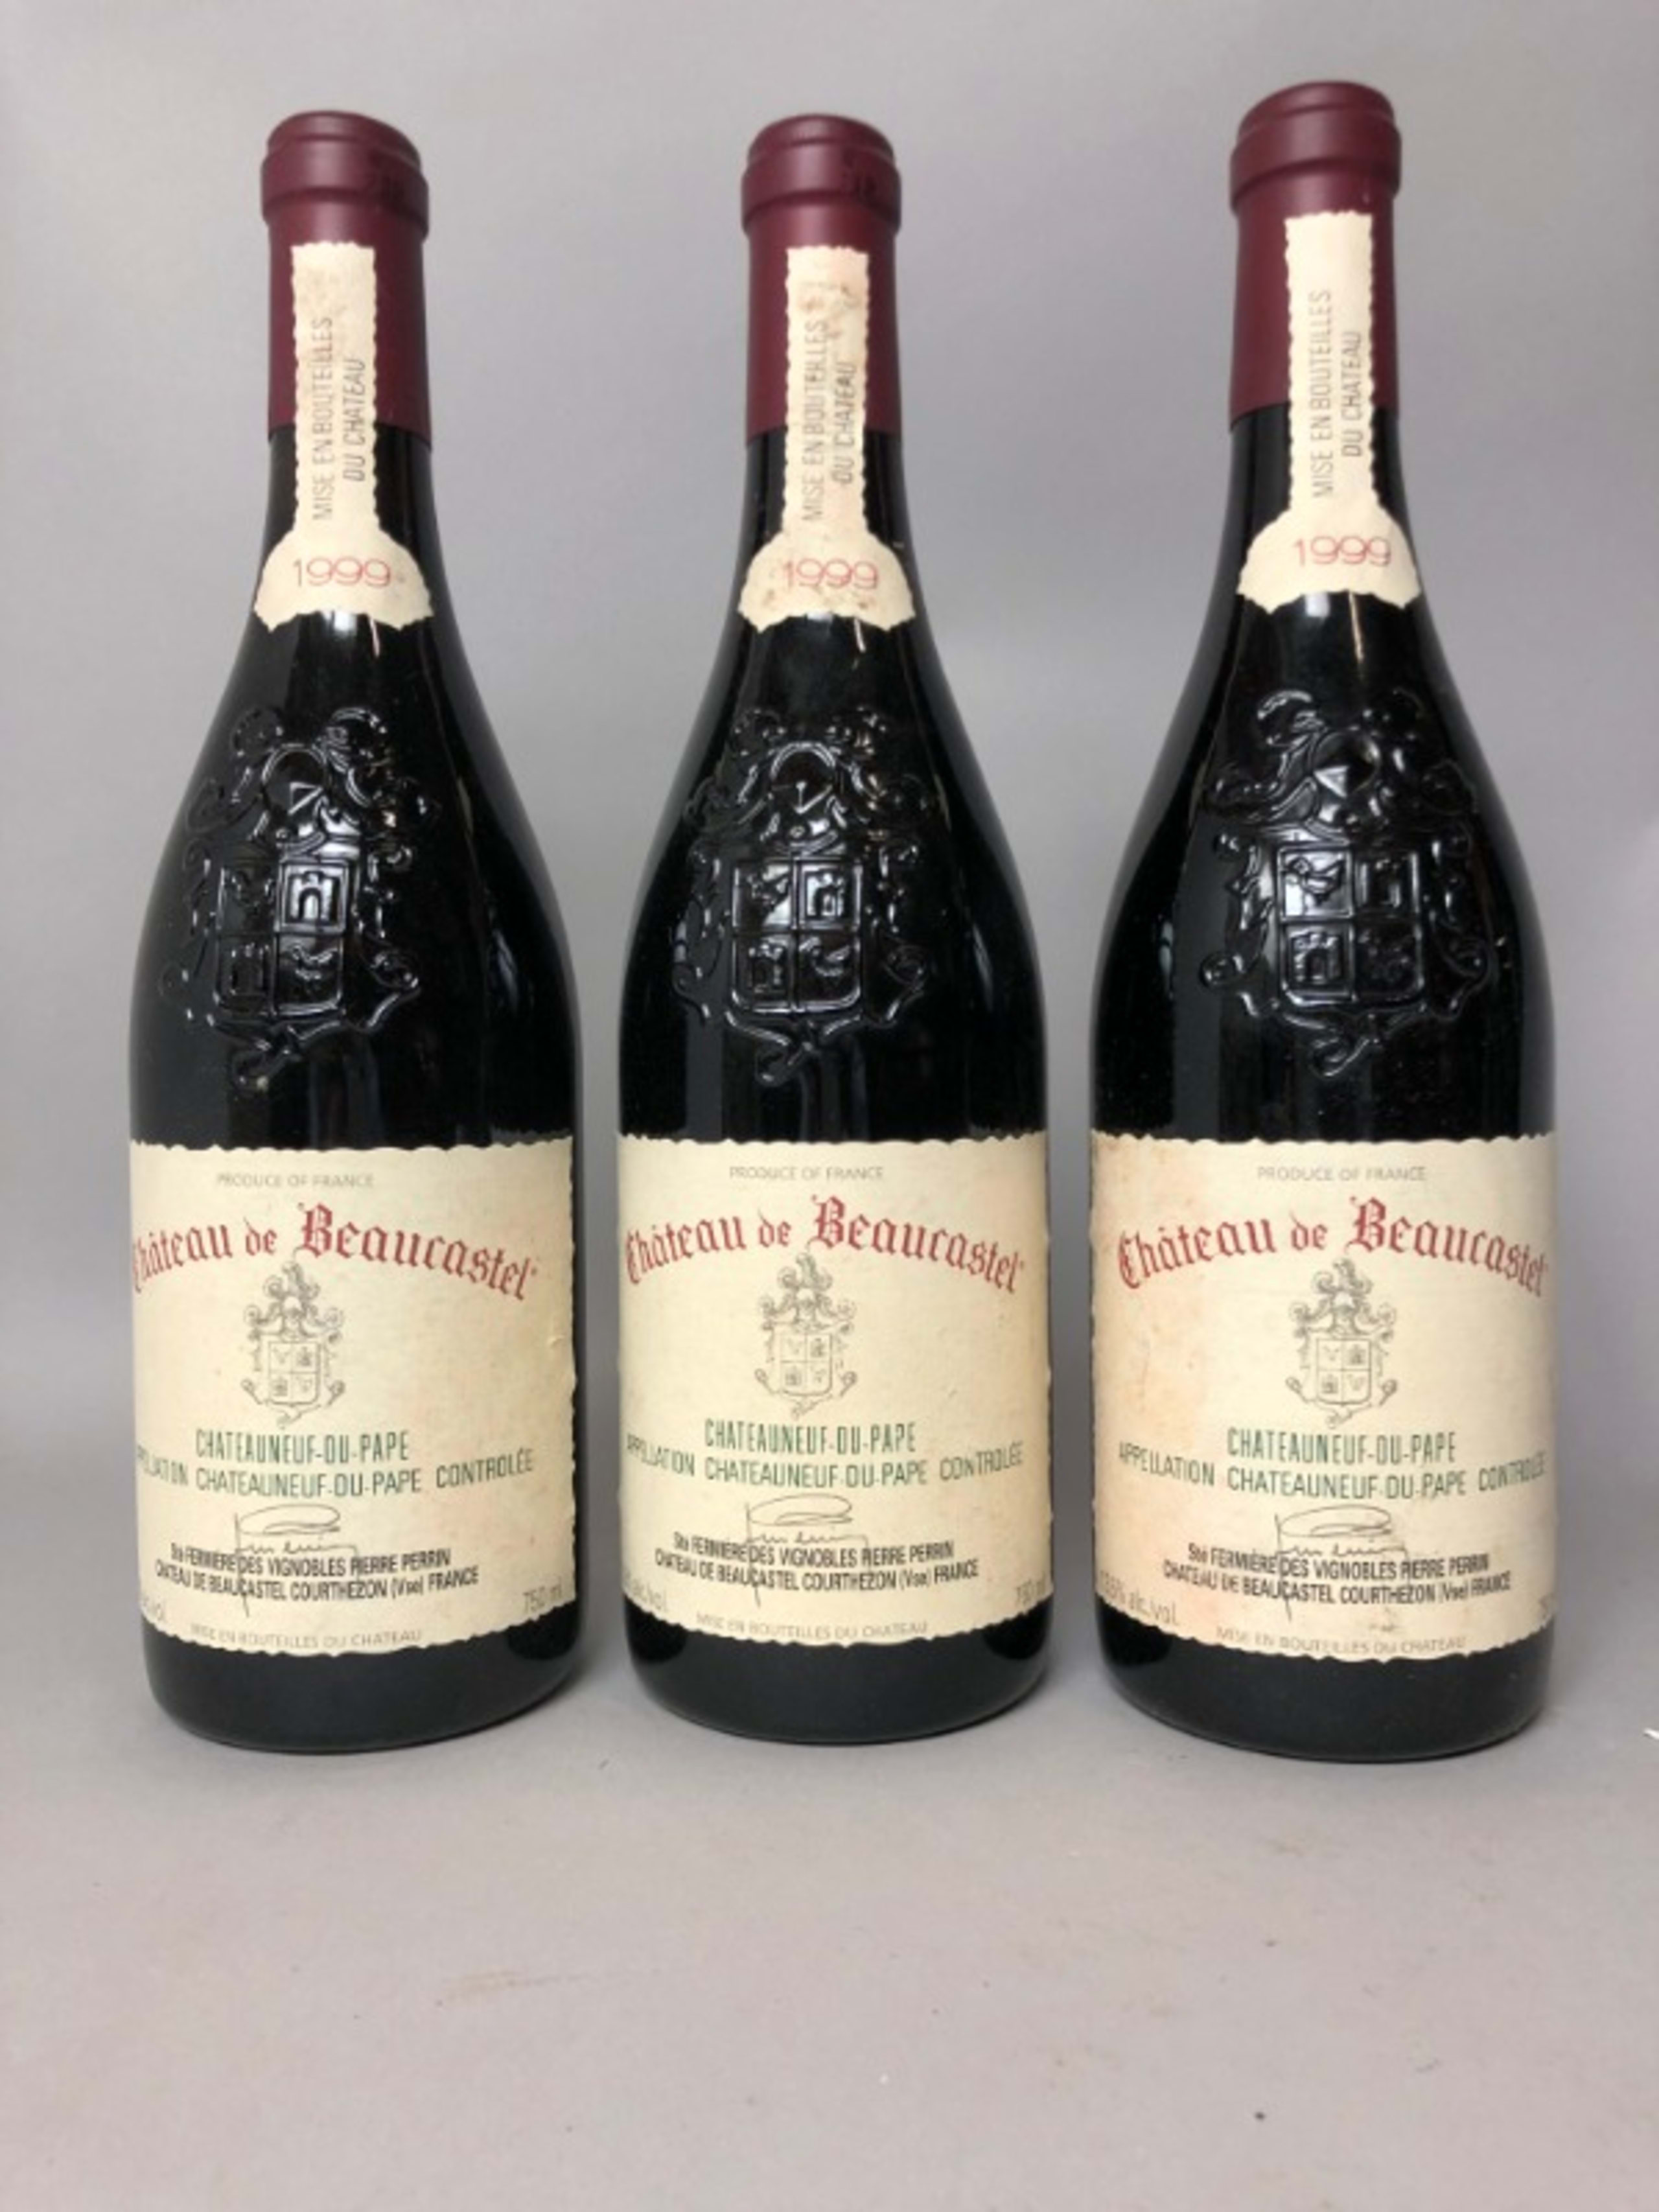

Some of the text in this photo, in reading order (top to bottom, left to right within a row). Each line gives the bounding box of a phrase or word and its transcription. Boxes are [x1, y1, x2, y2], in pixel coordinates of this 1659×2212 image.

[1308, 290, 1333, 498] MISE EN BOUTEILLES
[1340, 331, 1364, 458] DU CHATEAU
[312, 318, 334, 520] MISE EN BOUTEILLES
[343, 359, 365, 482] DU CHATEAU
[802, 321, 828, 520] MISE EN BOUTEILLES
[831, 362, 857, 484] DU CHATEAU
[1293, 535, 1392, 566] 1999
[293, 557, 391, 588] 1999
[783, 558, 879, 590] 1999
[216, 1173, 374, 1188] PRODUCE OF FRANCE
[729, 1167, 883, 1180] PRODUCE OF FRANCE
[1257, 1167, 1426, 1182] PRODUCE OF FRANCE
[243, 1217, 277, 1257] de
[299, 1202, 531, 1301] Beaucastel
[625, 1194, 1019, 1294] Château de Beaucastel
[1118, 1195, 1546, 1297] Château de Beaucastel
[196, 1428, 408, 1463] CHATEAUNEUF-DU-PAPE
[705, 1418, 916, 1455] CHATEAUNEUF-DU-PAPE
[1227, 1426, 1456, 1465] CHATEAUNEUF-DU-PAPE
[196, 1467, 422, 1498] CHATEAUNEUF-DU-PAPE
[705, 1456, 927, 1489] CHATEAUNEUF-DU-PAPE
[1119, 1442, 1215, 1487] APPELLATION
[1227, 1467, 1467, 1500] CHATEAUNEUF-DU-PAPE
[237, 1555, 263, 1575] DES
[268, 1556, 347, 1577] VIGNOBLES
[351, 1554, 397, 1575] PIERRE
[400, 1548, 451, 1570] PERRIN
[748, 1546, 774, 1566] DES
[779, 1546, 857, 1568] VIGNOBLES
[861, 1544, 905, 1567] PIERRE
[909, 1541, 955, 1563] PERRIN
[1279, 1556, 1309, 1578] DES
[1313, 1557, 1397, 1580] VIGNOBLES
[1400, 1557, 1444, 1579] PIERRE
[1448, 1553, 1489, 1575] PERRIN
[193, 1571, 207, 1591] DE
[209, 1574, 286, 1601] BEAUCASTEL
[291, 1579, 388, 1601] COURTHEZON
[428, 1565, 480, 1591] FRANCE
[699, 1561, 714, 1580] DE
[717, 1565, 799, 1591] BEAUCASTEL
[802, 1570, 896, 1592] COURTHEZON
[934, 1558, 979, 1585] FRANCE
[1163, 1559, 1218, 1590] CHATEAU
[1222, 1574, 1240, 1594] DE
[1242, 1575, 1336, 1603] BEAUCASTEL
[1340, 1583, 1436, 1604] COURTHEZON
[1471, 1569, 1511, 1596] FRANCE
[192, 1623, 423, 1649] MISE EN BOUTEILLES DU CHATEAU
[697, 1611, 927, 1640] MISE EN BOUTEILLES DU CHATEAU
[1216, 1625, 1467, 1655] MISE EN BOUTEILLES DU CHATEAU
